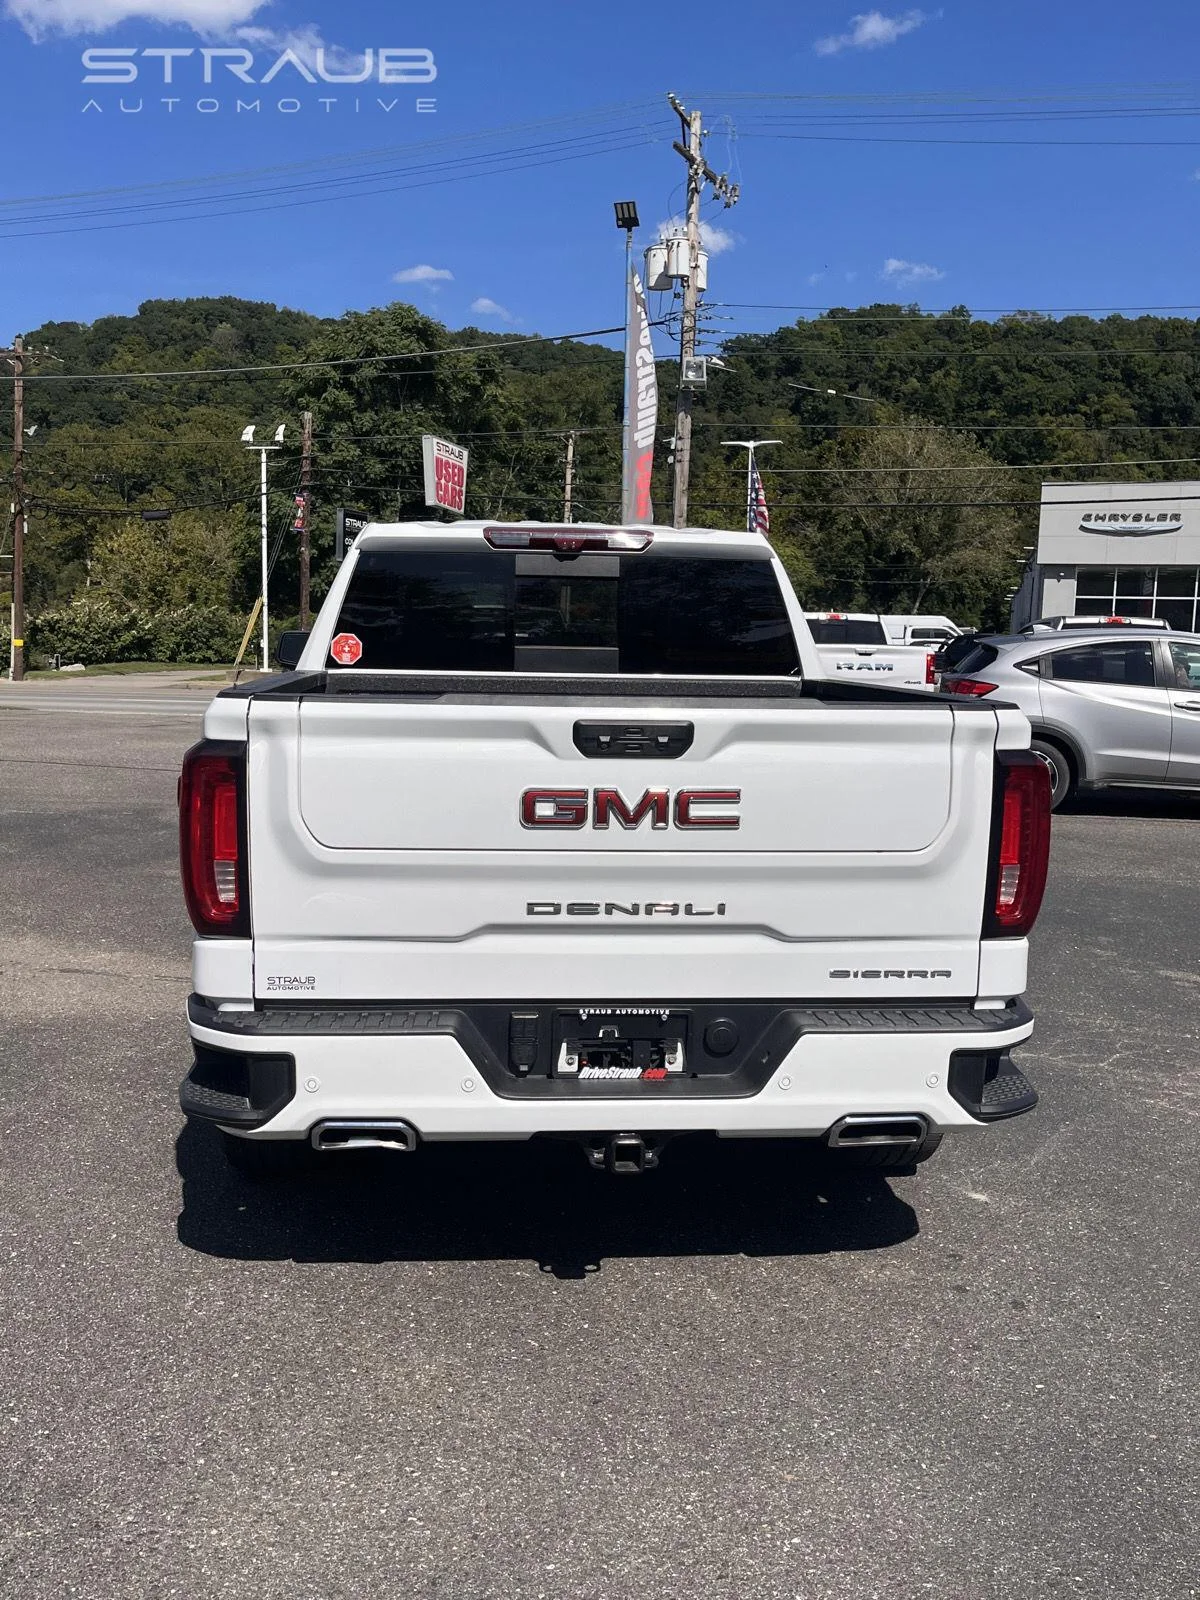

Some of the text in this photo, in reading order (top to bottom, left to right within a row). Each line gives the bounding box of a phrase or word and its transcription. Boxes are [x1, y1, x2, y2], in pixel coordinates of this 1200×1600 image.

[436, 441, 464, 461] STRAUB
[435, 455, 465, 488] USED
[436, 481, 463, 511] CARS
[1081, 513, 1182, 522] CHRYSLER
[836, 663, 894, 671] RAM
[520, 788, 741, 831] GMC
[526, 902, 727, 916] DENALI
[267, 976, 315, 984] STRAUB
[829, 969, 952, 979] SIERRA
